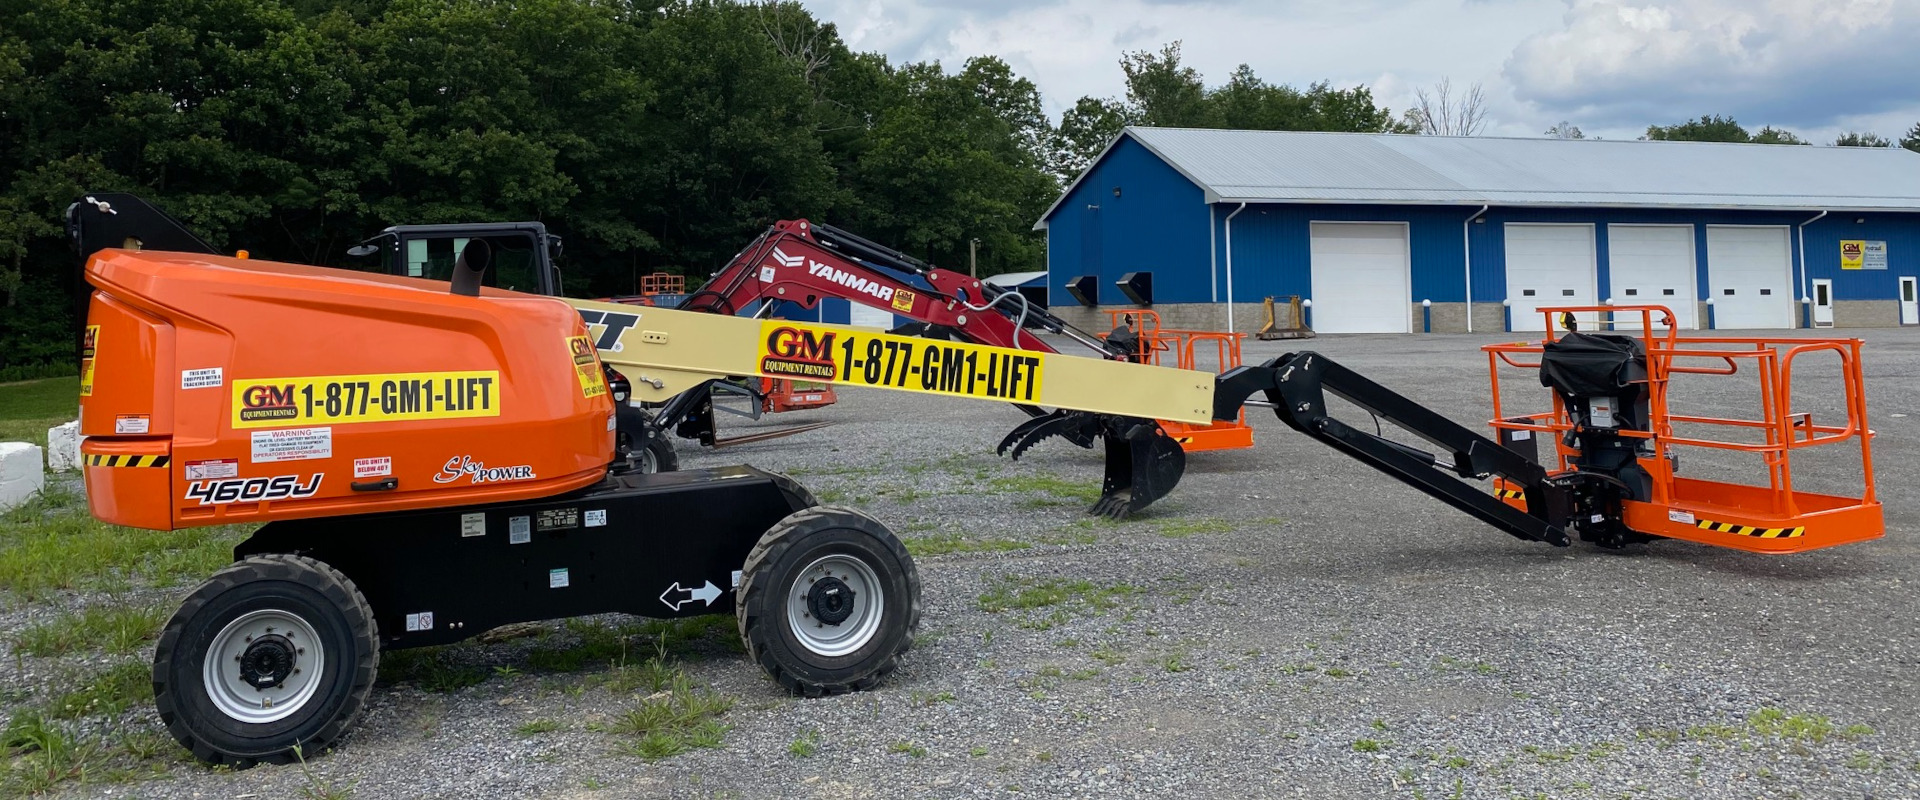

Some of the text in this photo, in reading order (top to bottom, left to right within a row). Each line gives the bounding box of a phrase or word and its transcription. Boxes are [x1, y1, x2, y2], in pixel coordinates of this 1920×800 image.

[809, 260, 893, 301] YANMAR
[767, 327, 836, 361] GM
[765, 360, 834, 377] EQUIPMENT RENTALS
[842, 336, 1040, 400] 1-877-GM1-LIFT
[242, 384, 296, 408] GM
[301, 378, 493, 417] 1-877-GM1-LIFT
[243, 408, 296, 419] EQUIPMENT RENTALS
[272, 429, 312, 438] WARNING
[434, 455, 531, 483] Sky POWER
